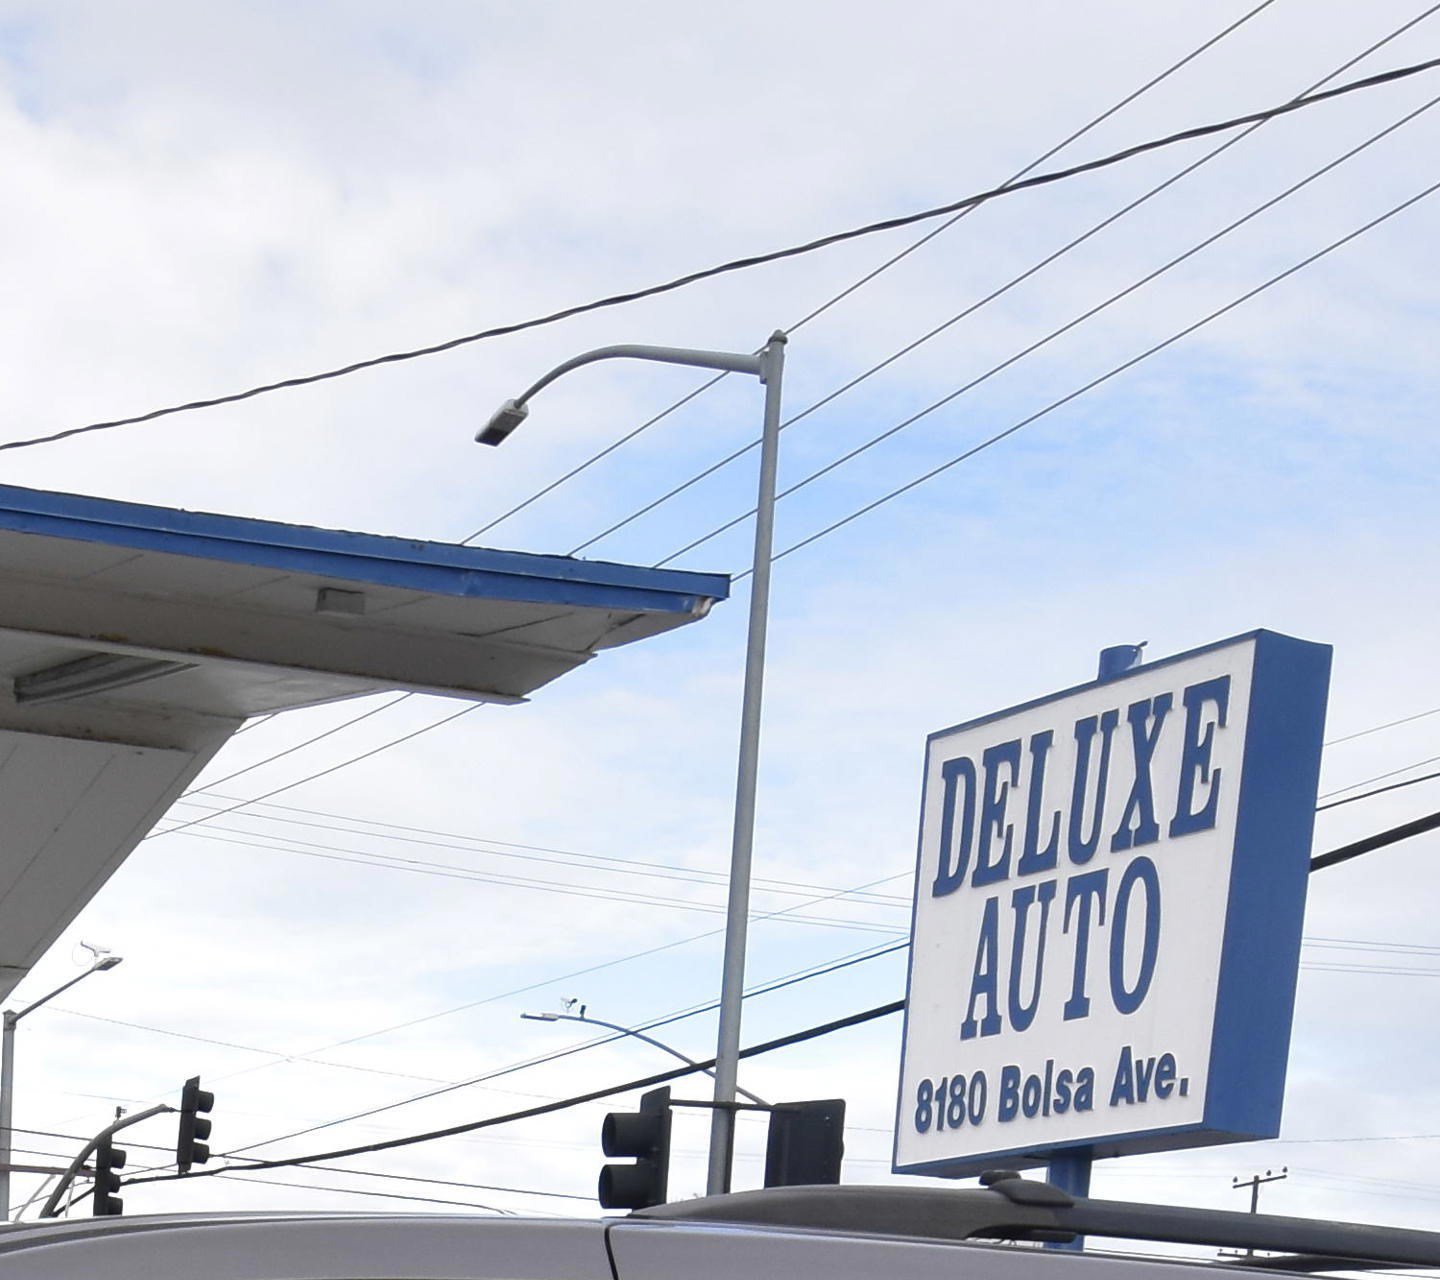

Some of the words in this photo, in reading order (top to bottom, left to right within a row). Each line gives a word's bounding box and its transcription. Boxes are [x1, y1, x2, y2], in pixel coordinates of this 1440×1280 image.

[931, 674, 1232, 898] DELUXE
[960, 856, 1162, 1041] AUTO
[914, 1069, 988, 1135] 8180
[998, 1058, 1095, 1123] Bolsa
[1109, 1045, 1189, 1107] Ave.
